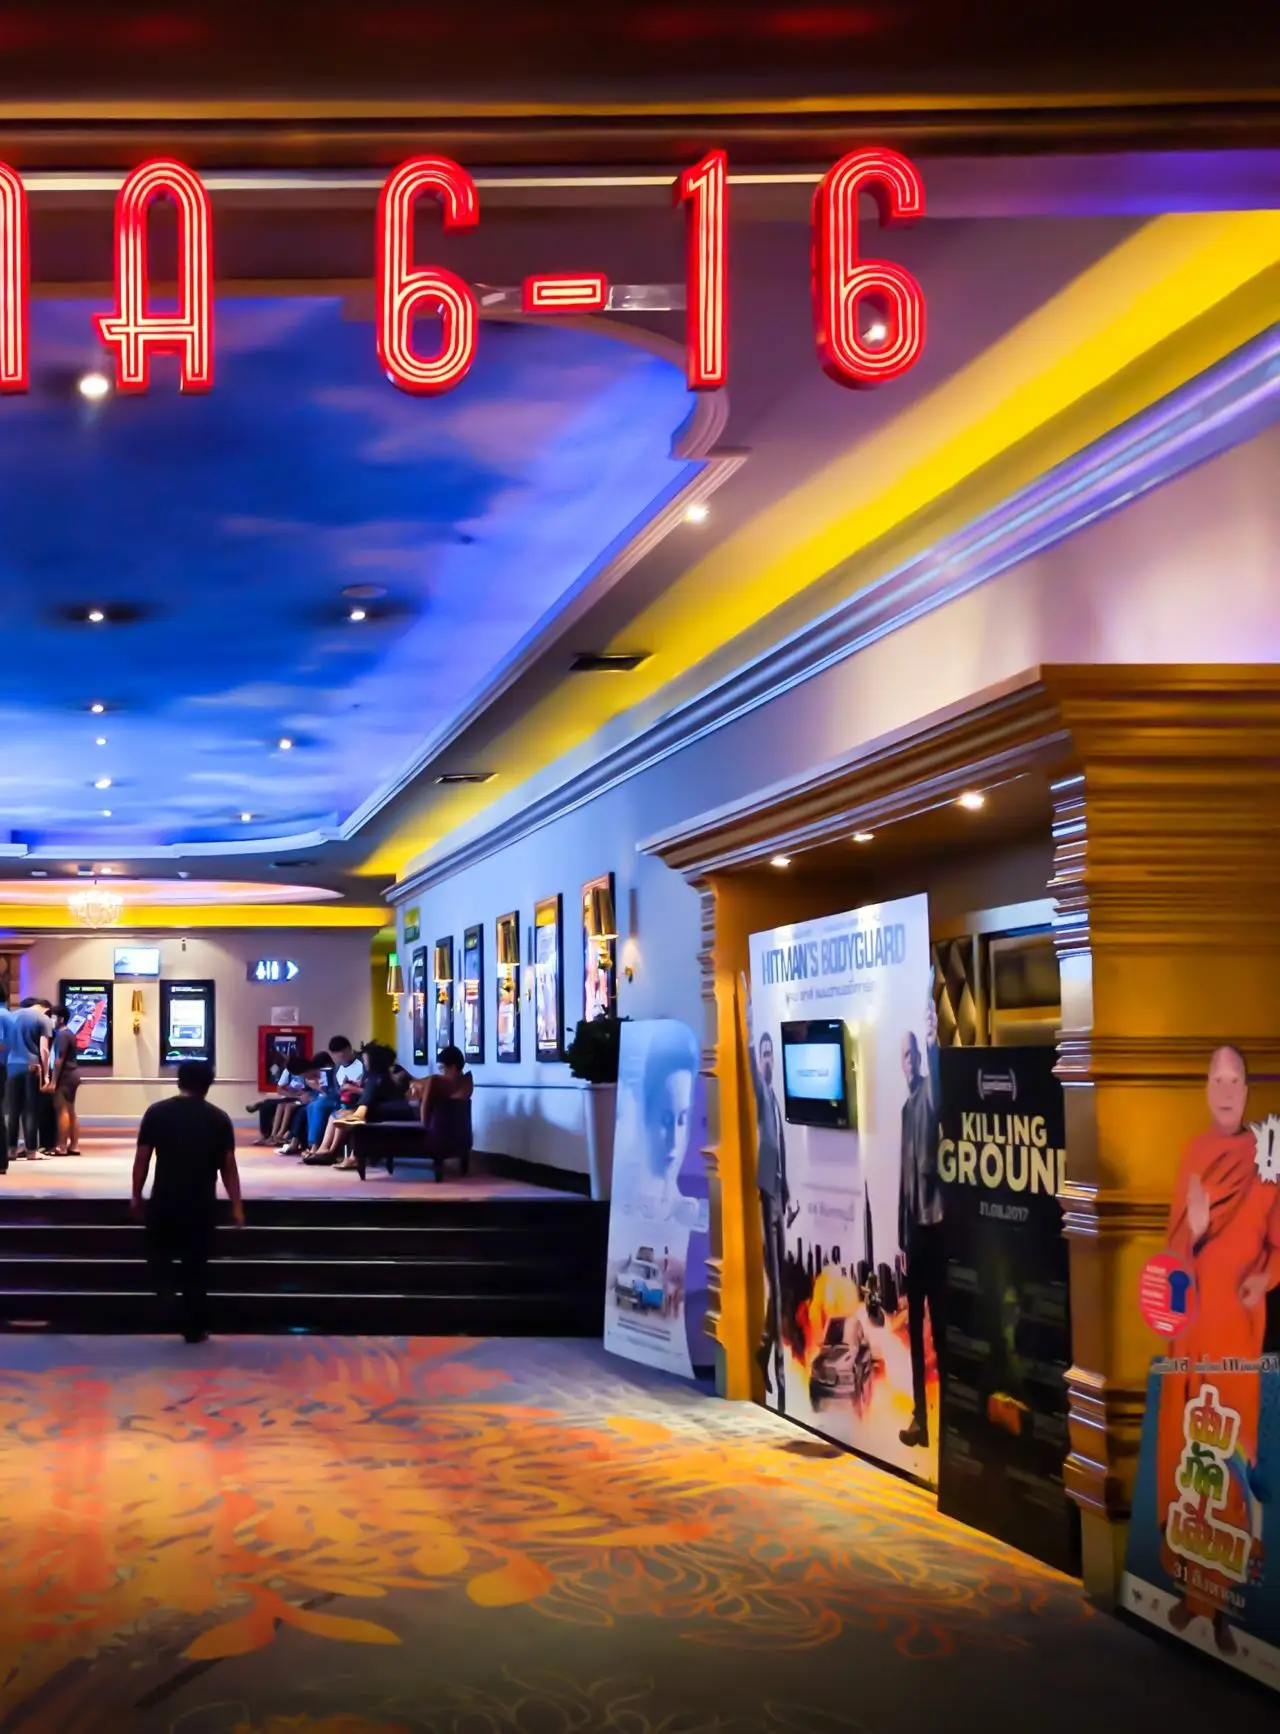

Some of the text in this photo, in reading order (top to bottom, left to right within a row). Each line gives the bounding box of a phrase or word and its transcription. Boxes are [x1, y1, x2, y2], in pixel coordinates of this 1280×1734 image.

[375, 147, 926, 393] 6-16
[762, 941, 818, 985] HITMAN'S
[821, 923, 906, 975] BODYGUARD
[962, 1112, 1047, 1148] KILLING
